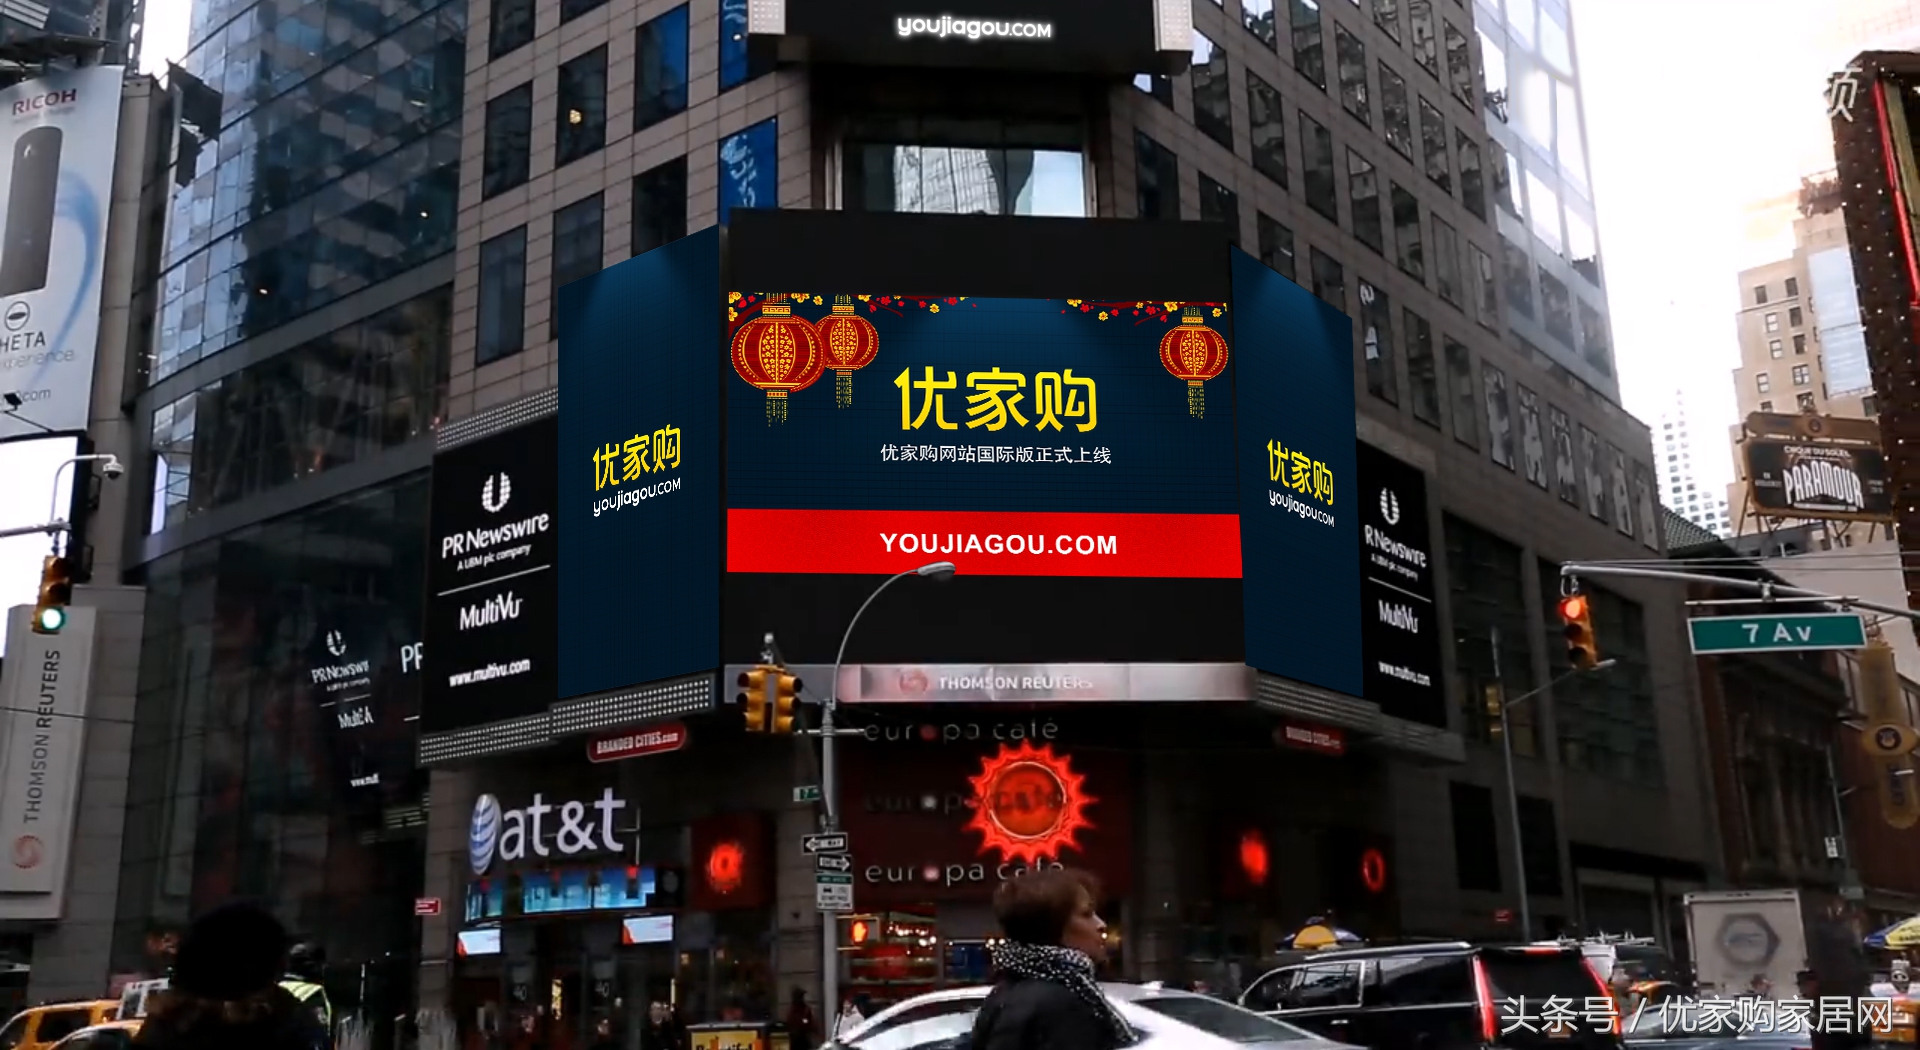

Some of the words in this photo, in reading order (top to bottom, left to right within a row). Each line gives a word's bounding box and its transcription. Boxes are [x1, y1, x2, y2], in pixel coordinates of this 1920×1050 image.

[12, 88, 77, 116] RICOH
[0, 331, 46, 353] HETA
[893, 366, 1098, 432] 优家购
[592, 423, 681, 491] 优家购
[880, 443, 1112, 465] 优家购网站国际版正式上线
[1266, 438, 1334, 506] 优家购
[1783, 459, 1865, 509] PARAMOUR
[496, 544, 532, 562] company
[879, 532, 1117, 555] YOUJIAGOU.COM
[460, 591, 522, 630] MultiVu
[1741, 624, 1759, 643] 7
[1773, 623, 1812, 643] Av
[36, 649, 60, 728] REUTERS
[449, 658, 531, 687] www.multivu.com
[939, 676, 1018, 690] THOMSON
[23, 734, 50, 825] THOMSON
[499, 786, 626, 861] at&t
